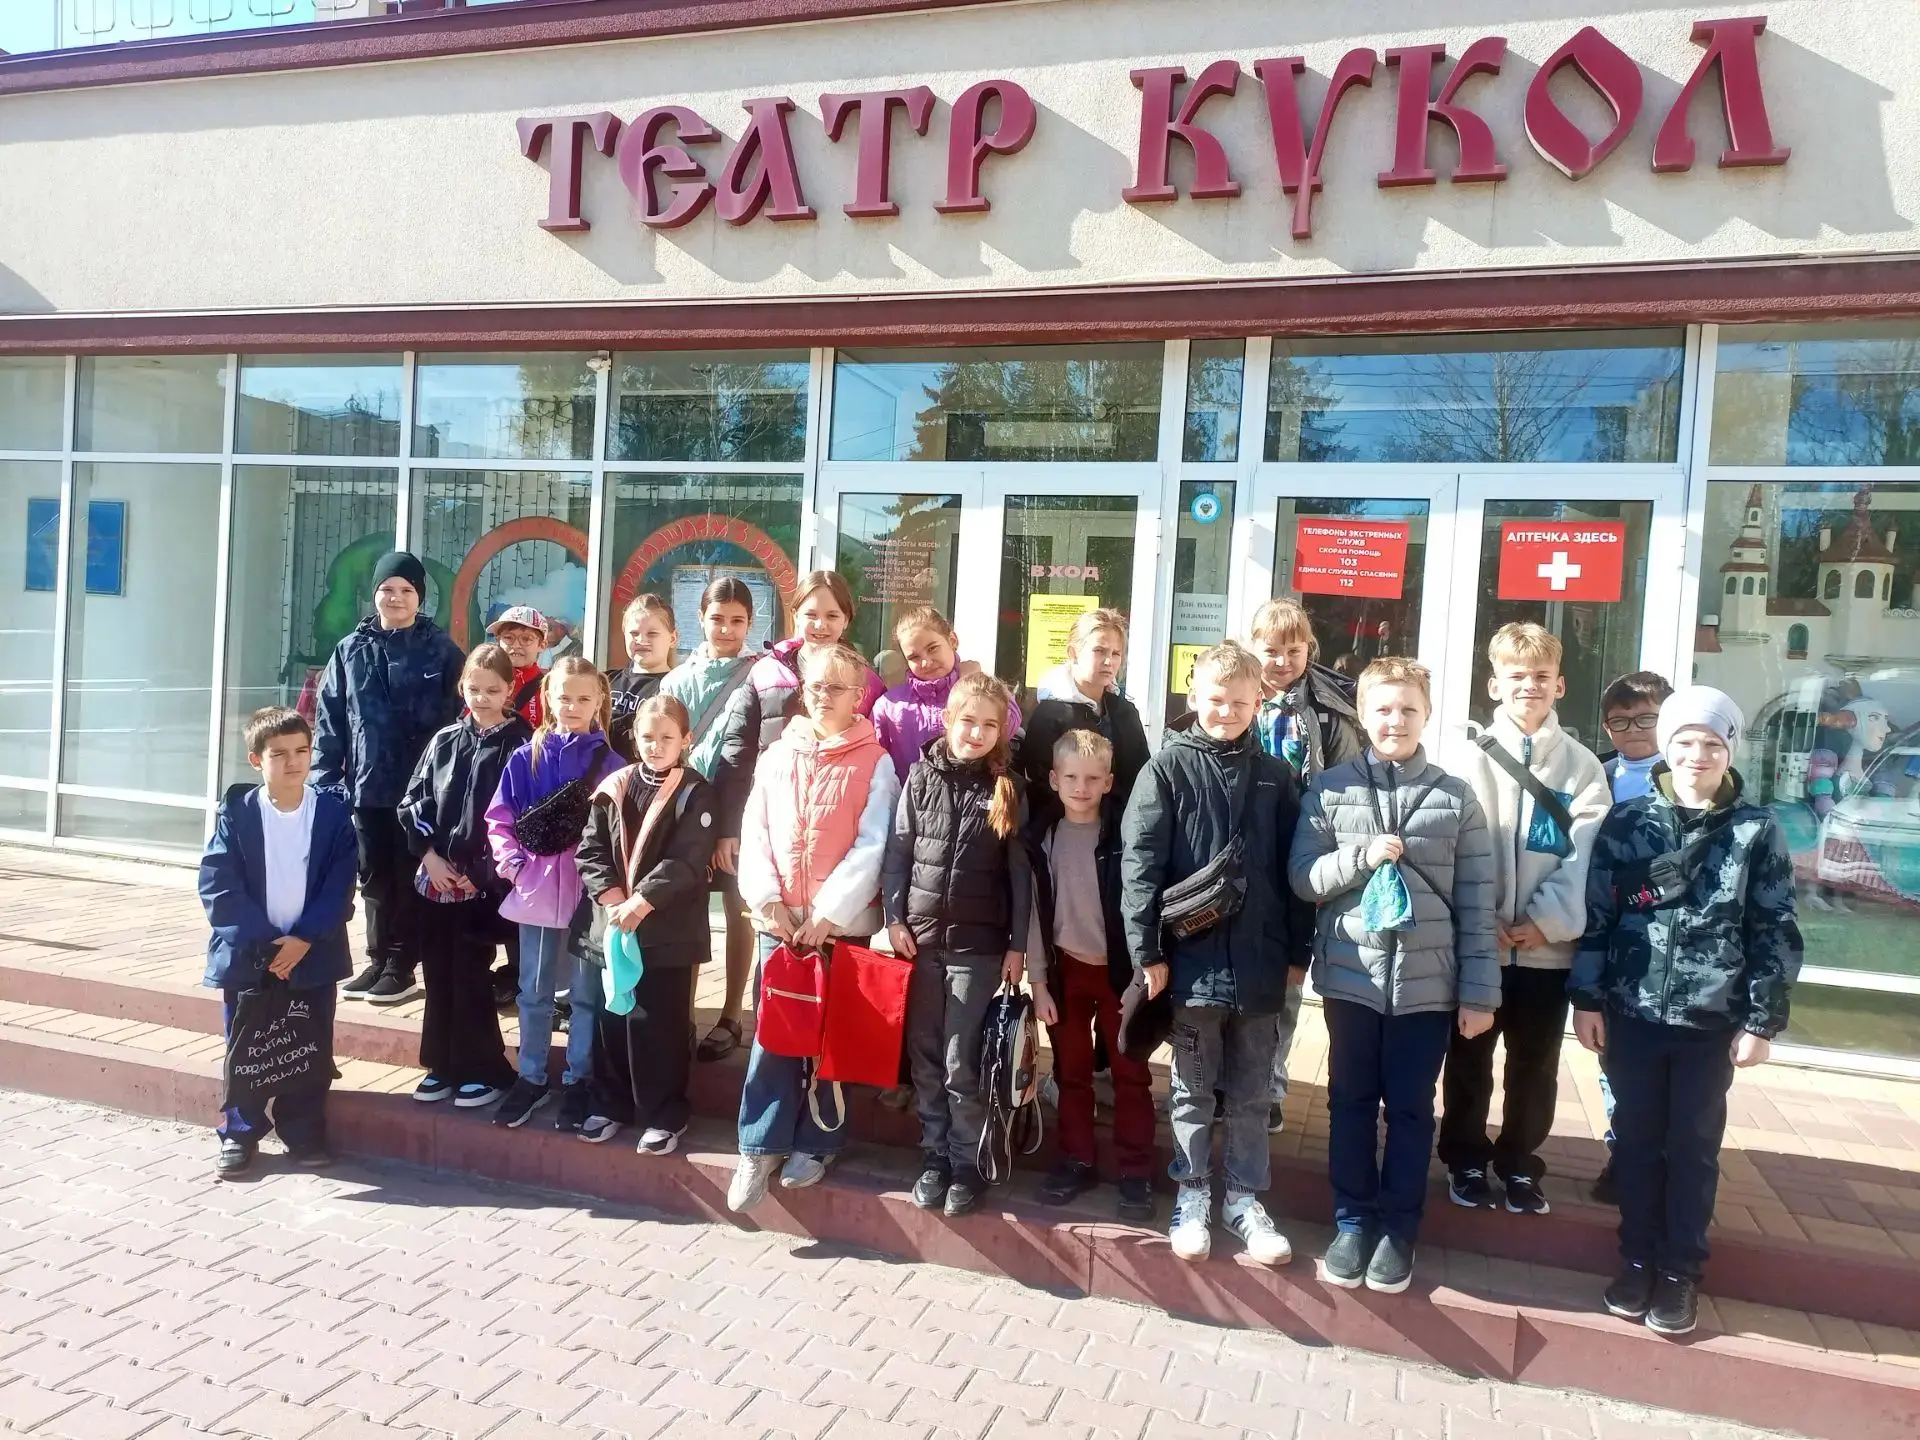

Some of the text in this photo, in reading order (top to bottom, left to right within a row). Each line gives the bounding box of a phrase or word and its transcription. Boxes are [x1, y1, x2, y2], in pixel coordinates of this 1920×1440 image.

[515, 15, 1791, 239] ТЕАТР КУКОЛ
[1302, 527, 1402, 539] ТЕЛЕФОНЫ ЭКСТРЕННЫХ
[1506, 531, 1618, 544] АПТЕЧКА ЗДЕСЬ
[1336, 538, 1366, 547] СЛУЖБ
[1318, 547, 1382, 557] СКОРАЯ ПОМОЩЬ
[1340, 557, 1358, 567] 103
[1031, 564, 1100, 581] ВХОД
[1298, 566, 1399, 578] ЕДИНАЯ СЛУЖБА СПАСЕНИЯ
[1339, 578, 1354, 587] 112
[1184, 910, 1216, 929] PUMA
[234, 1057, 274, 1076] POPRAW
